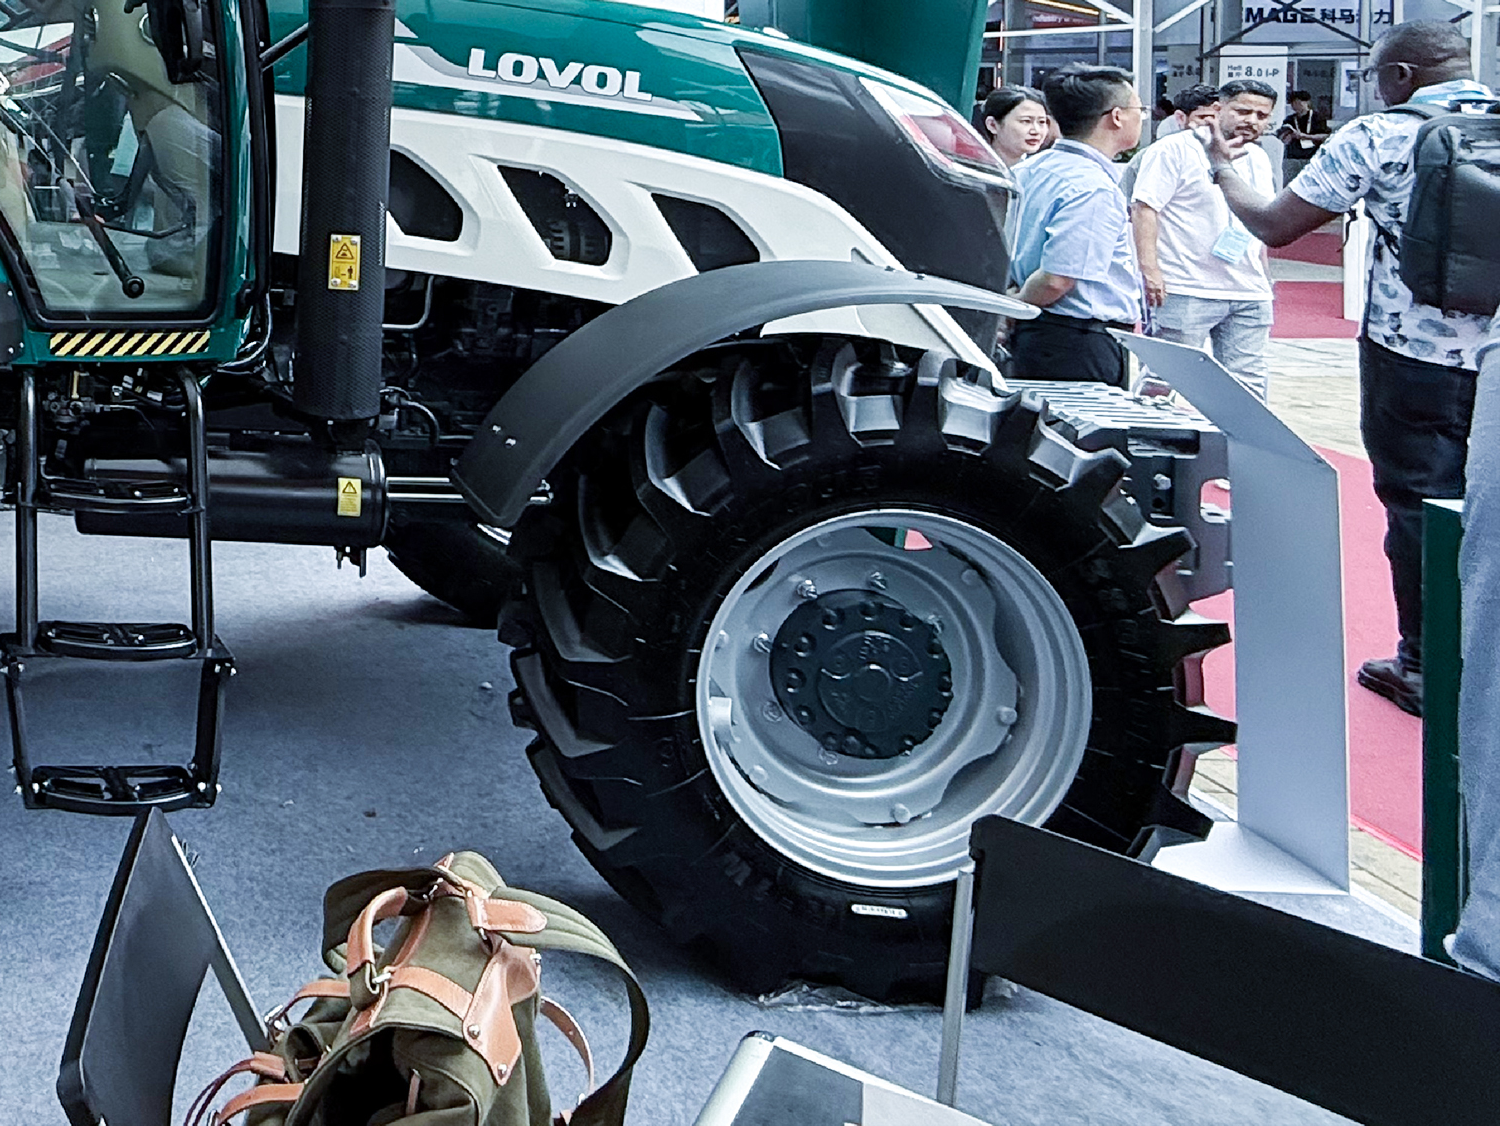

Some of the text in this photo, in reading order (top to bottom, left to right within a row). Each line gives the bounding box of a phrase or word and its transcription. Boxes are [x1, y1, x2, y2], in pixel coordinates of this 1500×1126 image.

[1320, 8, 1391, 25] 科马力
[468, 47, 652, 101] LOVOL
